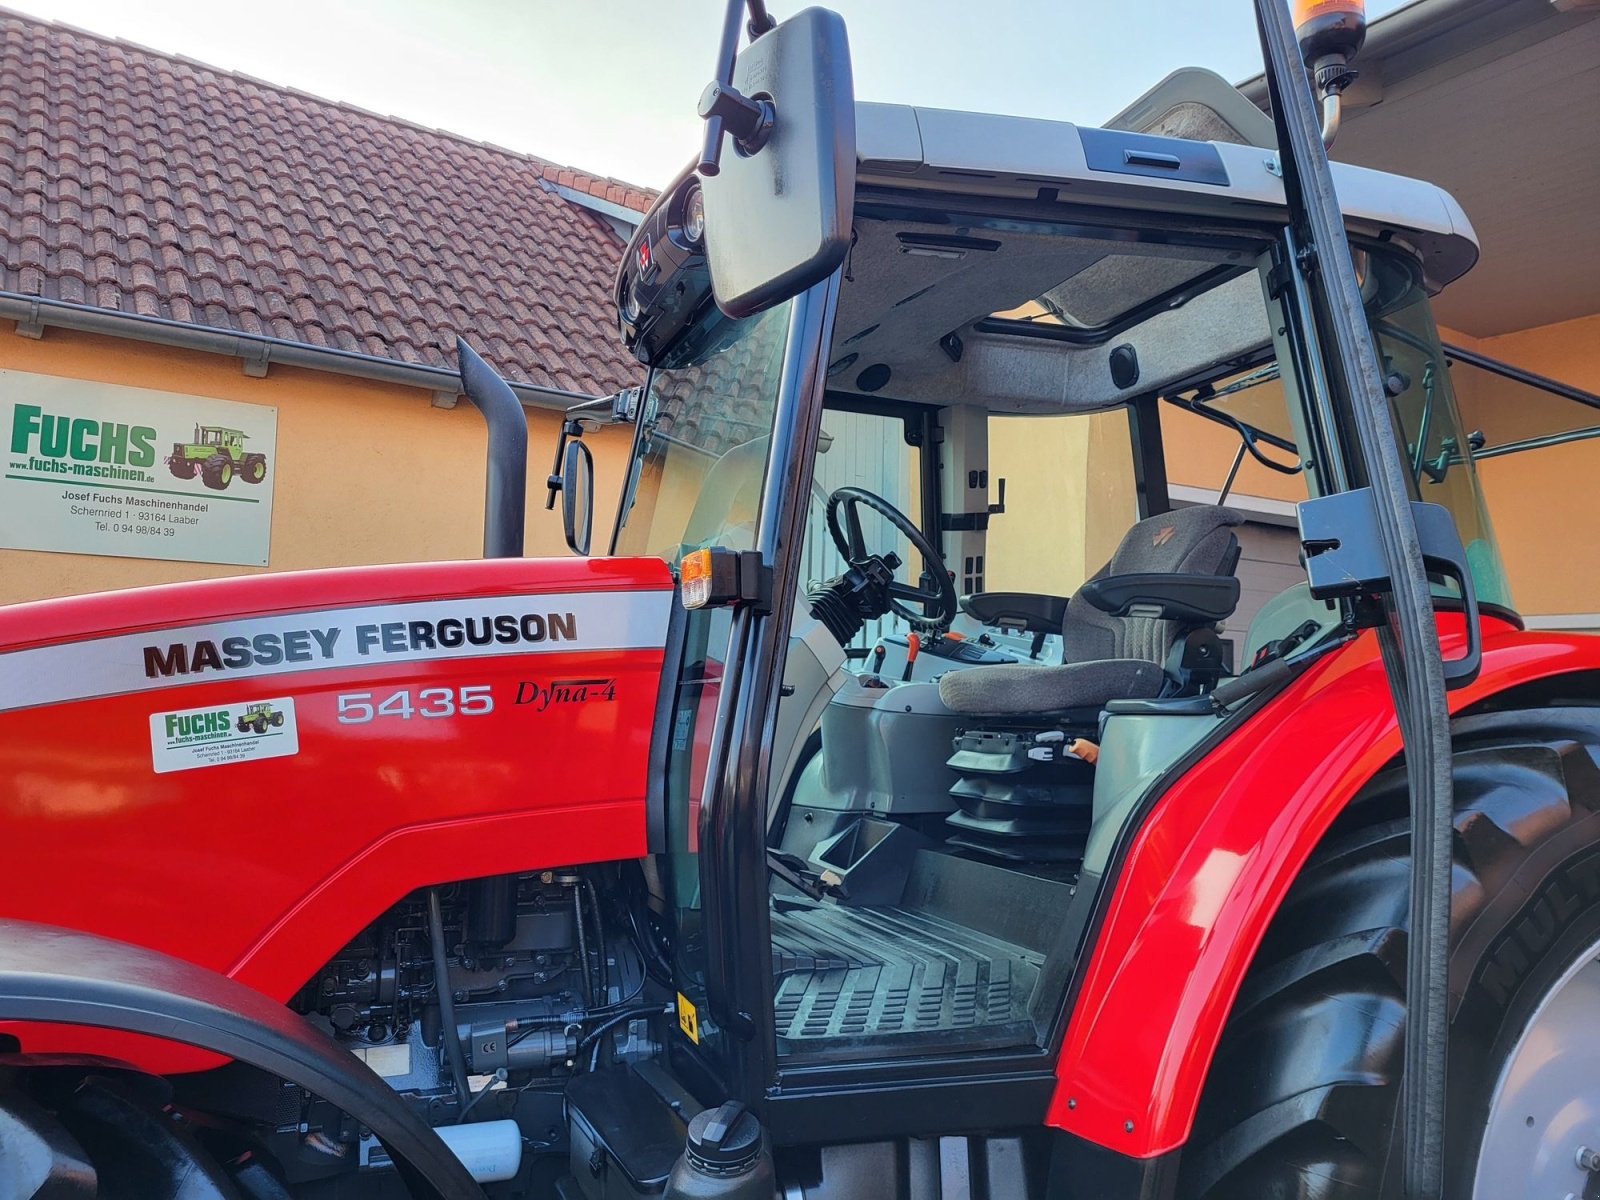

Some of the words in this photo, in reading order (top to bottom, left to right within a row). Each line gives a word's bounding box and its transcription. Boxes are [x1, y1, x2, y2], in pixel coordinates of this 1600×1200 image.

[11, 403, 157, 468] FUCHS
[9, 456, 155, 483] www.fuchs-maschinen.de
[61, 490, 90, 501] Josef
[92, 493, 123, 505] Fuchs
[125, 496, 209, 513] Maschinenhandel
[70, 504, 122, 519] Schernried
[125, 511, 129, 519] 1
[138, 511, 166, 522] 93164
[168, 514, 199, 526] Laaber
[95, 521, 111, 532] Tel.
[113, 523, 119, 533] 0
[121, 524, 133, 534] 94
[135, 525, 161, 536] 98/84
[163, 527, 175, 537] 39
[143, 627, 341, 678] MASSEY
[355, 612, 578, 656] FERGUSON
[336, 684, 495, 725] 5435
[514, 678, 617, 712] Dyna-4
[164, 710, 231, 738] FUCHS
